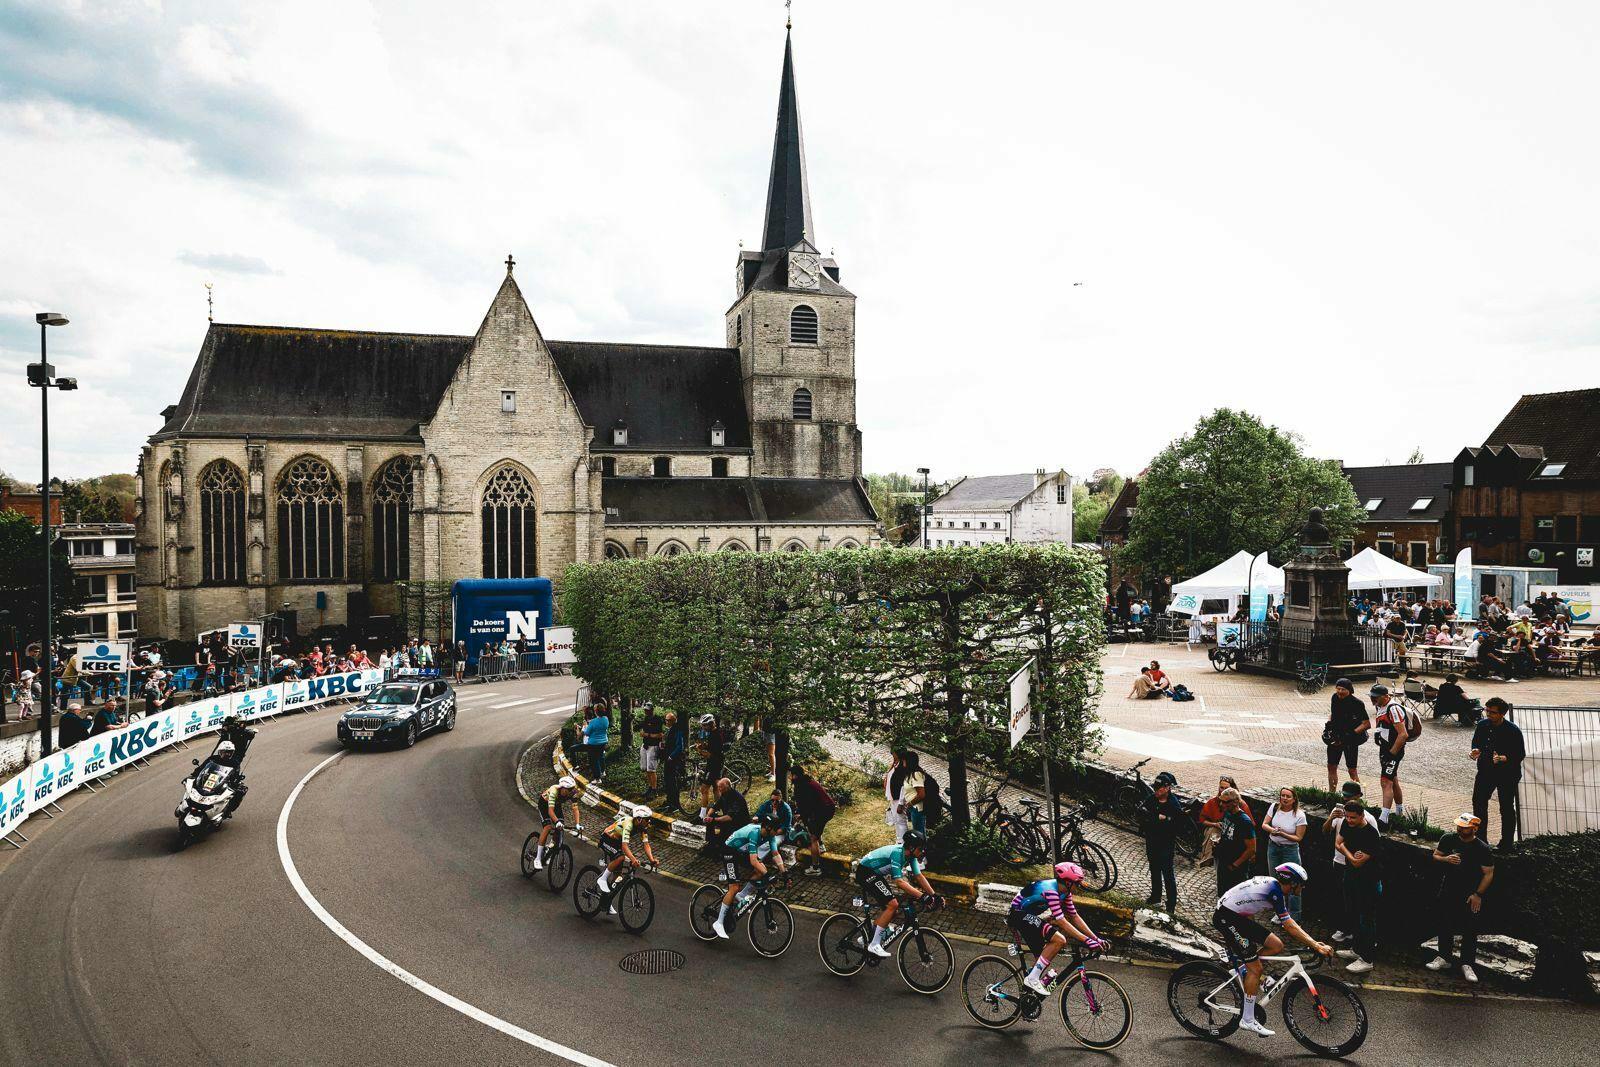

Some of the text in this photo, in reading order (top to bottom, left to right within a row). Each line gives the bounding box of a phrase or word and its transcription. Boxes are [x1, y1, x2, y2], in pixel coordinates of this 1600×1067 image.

[506, 610, 539, 640] N
[231, 638, 256, 647] KBC
[82, 661, 121, 671] KBC
[308, 673, 362, 700] KBC
[364, 683, 379, 692] KB
[260, 701, 277, 711] KBC
[285, 695, 305, 706] KBC
[184, 722, 201, 735] KBC
[109, 720, 159, 765] KBC
[160, 730, 174, 743] KBC
[84, 758, 105, 776] KBC
[57, 771, 73, 789] KBC
[34, 782, 53, 801] KBC
[10, 800, 25, 821] KBC
